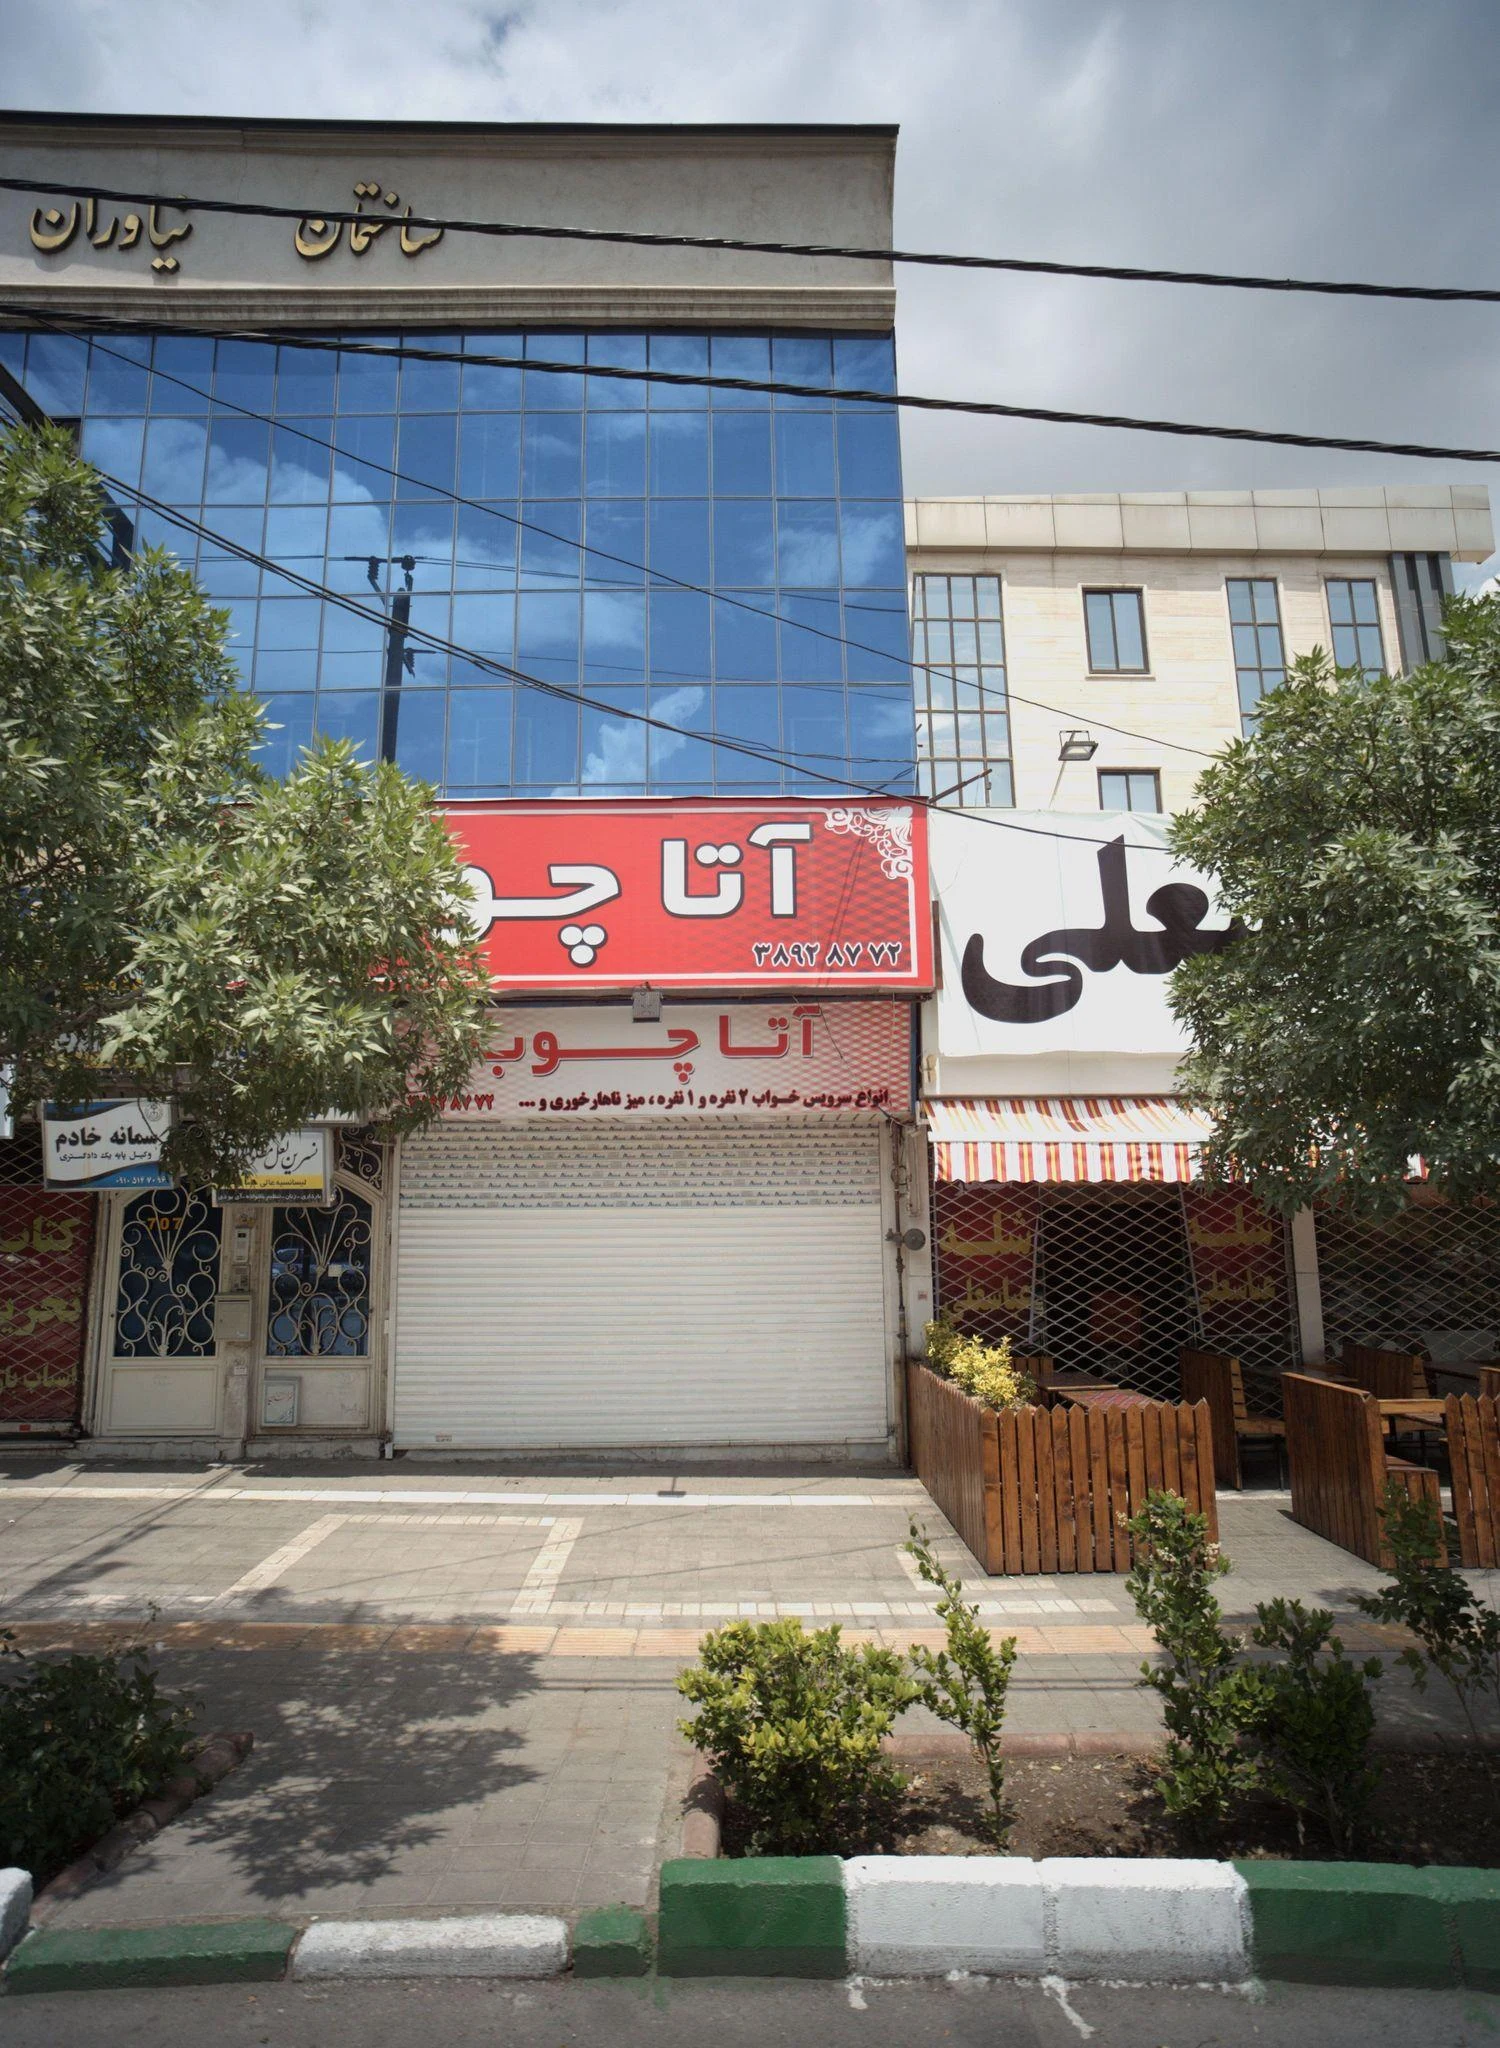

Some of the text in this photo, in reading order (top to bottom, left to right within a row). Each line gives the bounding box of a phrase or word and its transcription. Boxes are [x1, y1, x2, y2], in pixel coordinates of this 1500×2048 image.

[30, 182, 445, 274] ساختمان نیاوران
[430, 822, 813, 968] آتا چو
[752, 941, 902, 967] ۳۸۹۲ ۸۷ ۷۲
[718, 1004, 821, 1059] آتا
[474, 1094, 495, 1111] ۷۲
[537, 1098, 548, 1111] و
[623, 1094, 646, 1111] میز
[698, 1096, 708, 1109] و
[709, 1089, 737, 1109] نفره
[738, 1088, 749, 1105] ۲
[751, 1089, 801, 1109] خواب
[802, 1093, 853, 1109] سرویس
[854, 1089, 889, 1109] انواع
[55, 1126, 160, 1153] سمانه خادم
[60, 1151, 152, 1162] وکیل پایه یک دادگستری
[281, 1141, 319, 1175] نسرین
[147, 1217, 184, 1231] 707
